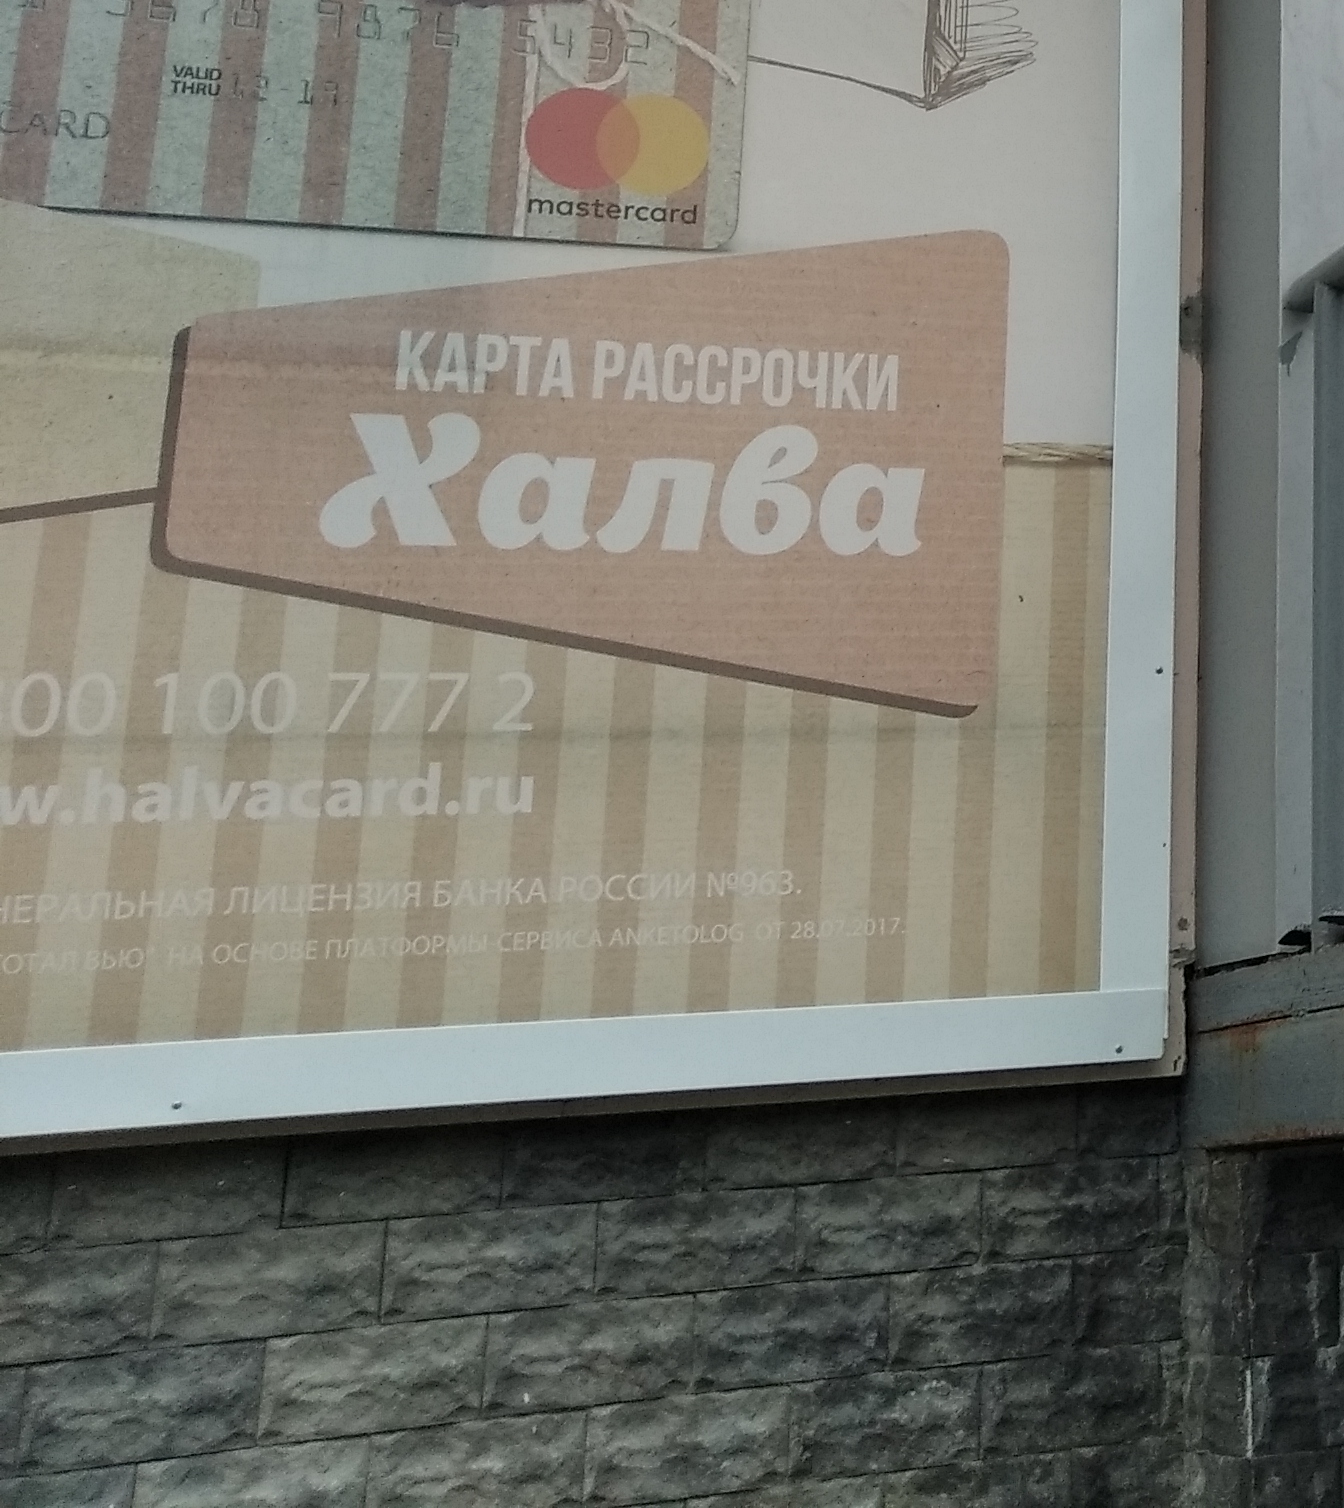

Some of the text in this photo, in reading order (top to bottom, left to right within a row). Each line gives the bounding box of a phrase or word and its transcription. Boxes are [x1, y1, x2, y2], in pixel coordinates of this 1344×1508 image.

[170, 79, 222, 97] THRU
[172, 64, 223, 82] VALID
[526, 197, 699, 226] mastercard
[395, 328, 900, 414] КАРТА РАССРОЧКИ
[318, 411, 928, 557] Халва
[151, 672, 298, 736] 100
[325, 672, 472, 735] 777
[491, 672, 535, 734] 2
[223, 880, 422, 918] ЛИЦЕНЗИЯ
[432, 876, 548, 908] БАНКА
[557, 871, 699, 904] РОССИИ
[706, 868, 803, 899] №963.
[212, 939, 319, 966] ОСНОВЕ
[608, 921, 745, 948] ANKETOLOG
[755, 920, 786, 941] ОТ
